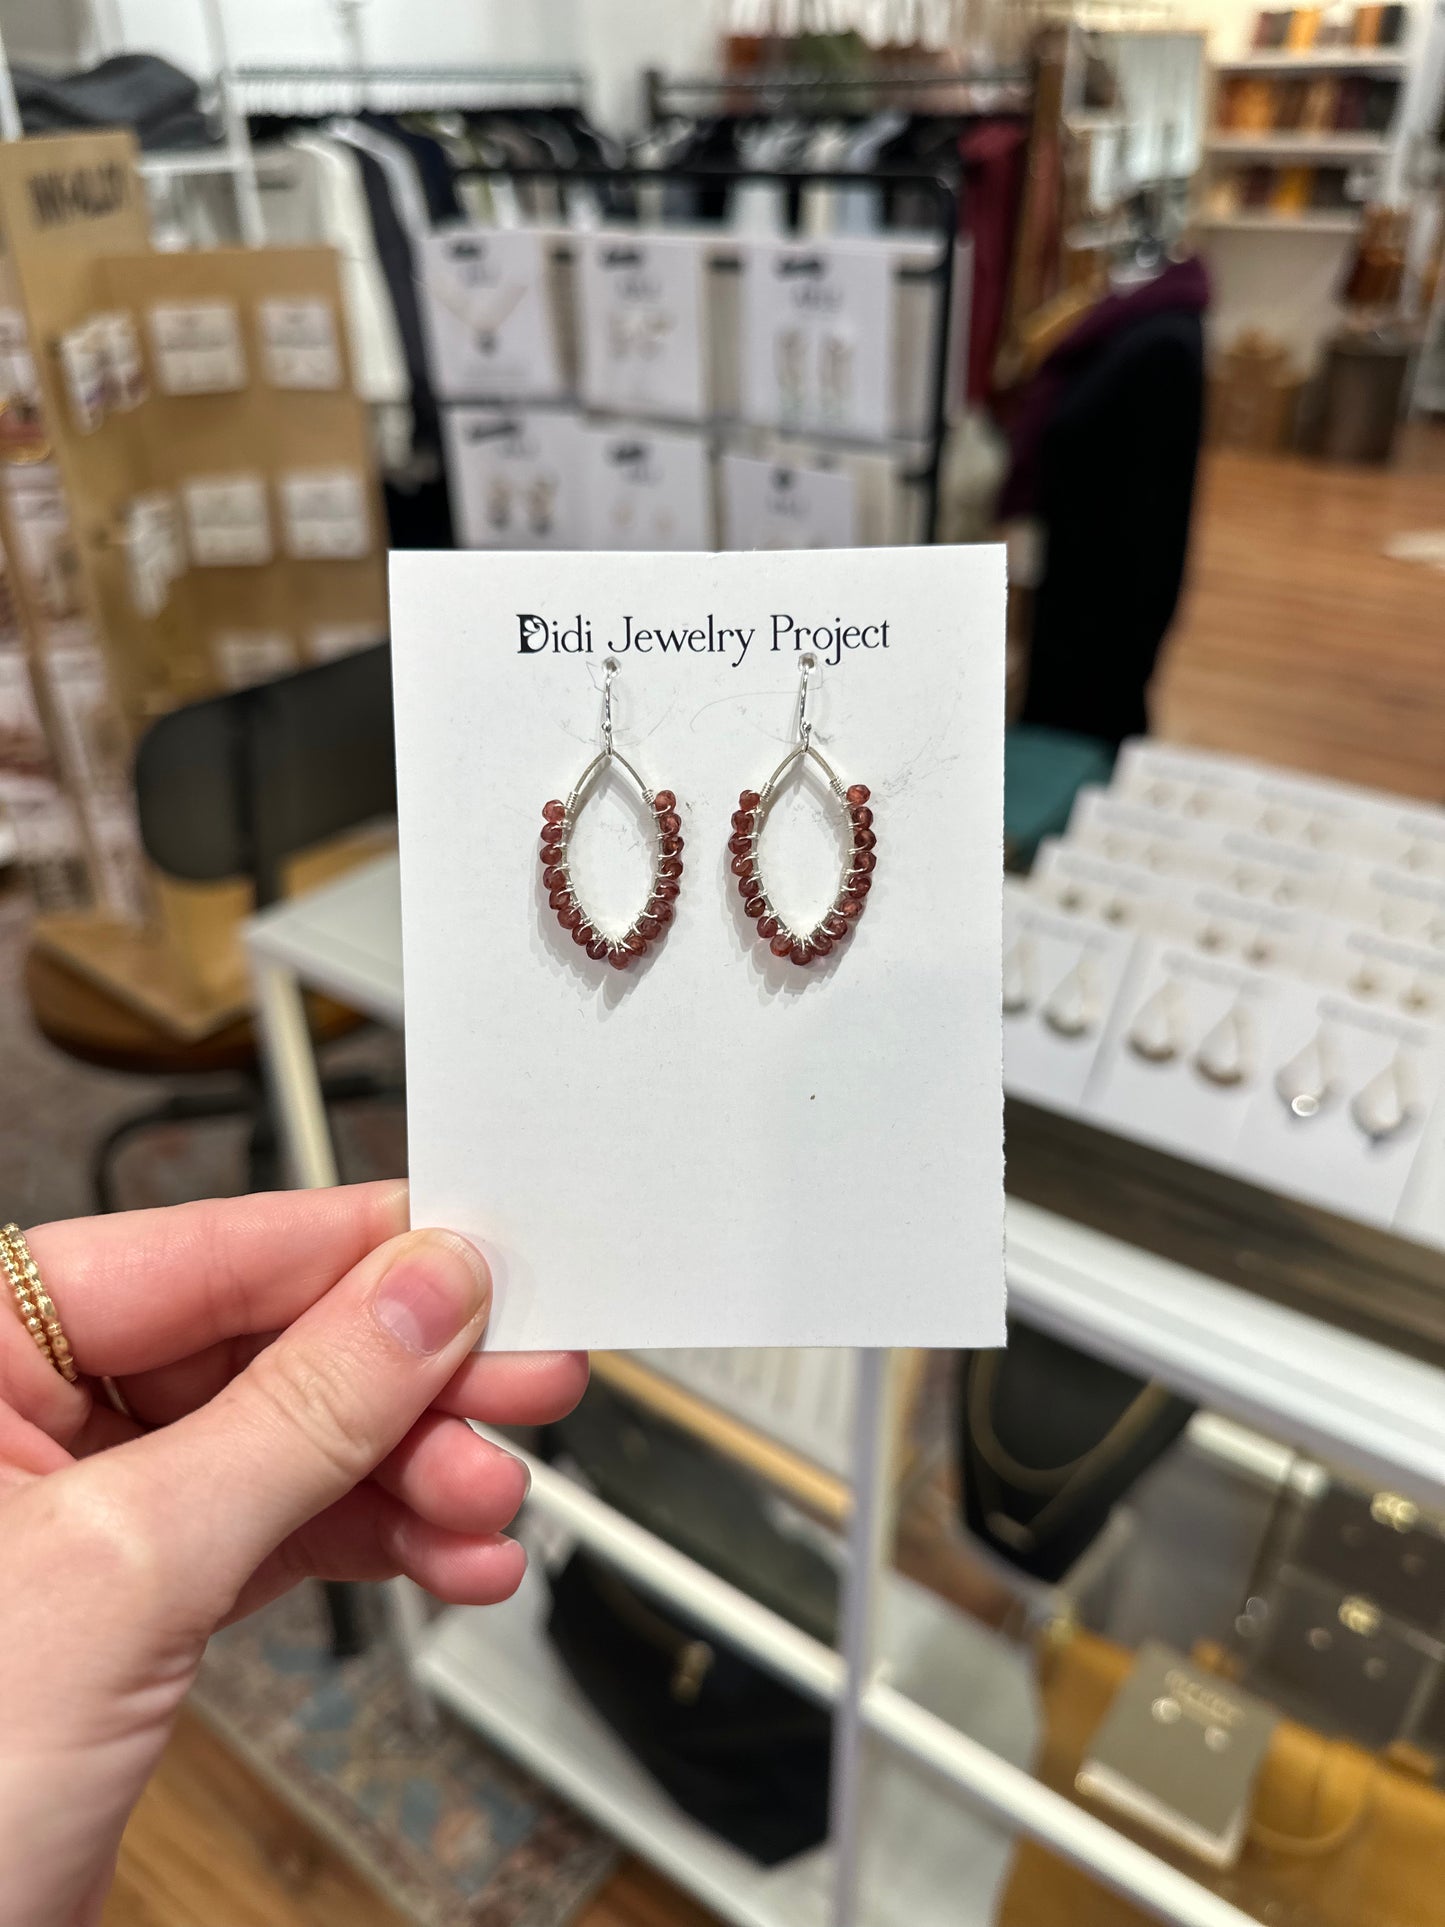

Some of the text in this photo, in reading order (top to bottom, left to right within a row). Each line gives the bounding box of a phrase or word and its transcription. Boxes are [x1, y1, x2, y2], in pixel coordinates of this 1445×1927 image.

[516, 614, 890, 668] Didi Jewelry Project
